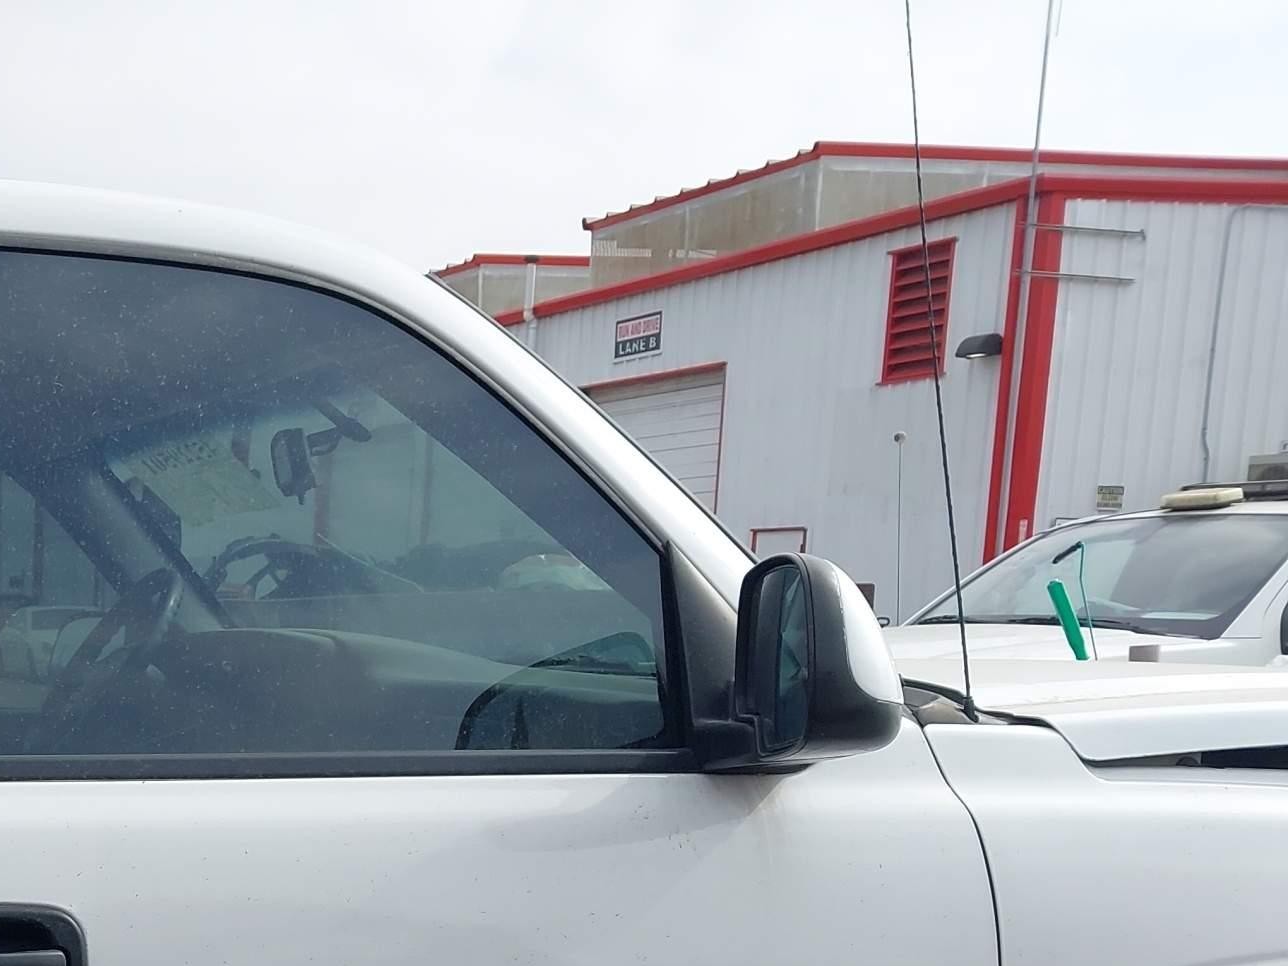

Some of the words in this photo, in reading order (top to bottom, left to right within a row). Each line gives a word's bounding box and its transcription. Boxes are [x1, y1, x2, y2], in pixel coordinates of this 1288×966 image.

[631, 320, 641, 335] AND
[643, 316, 658, 333] DRIVE
[619, 337, 646, 354] LANE
[649, 336, 657, 348] B
